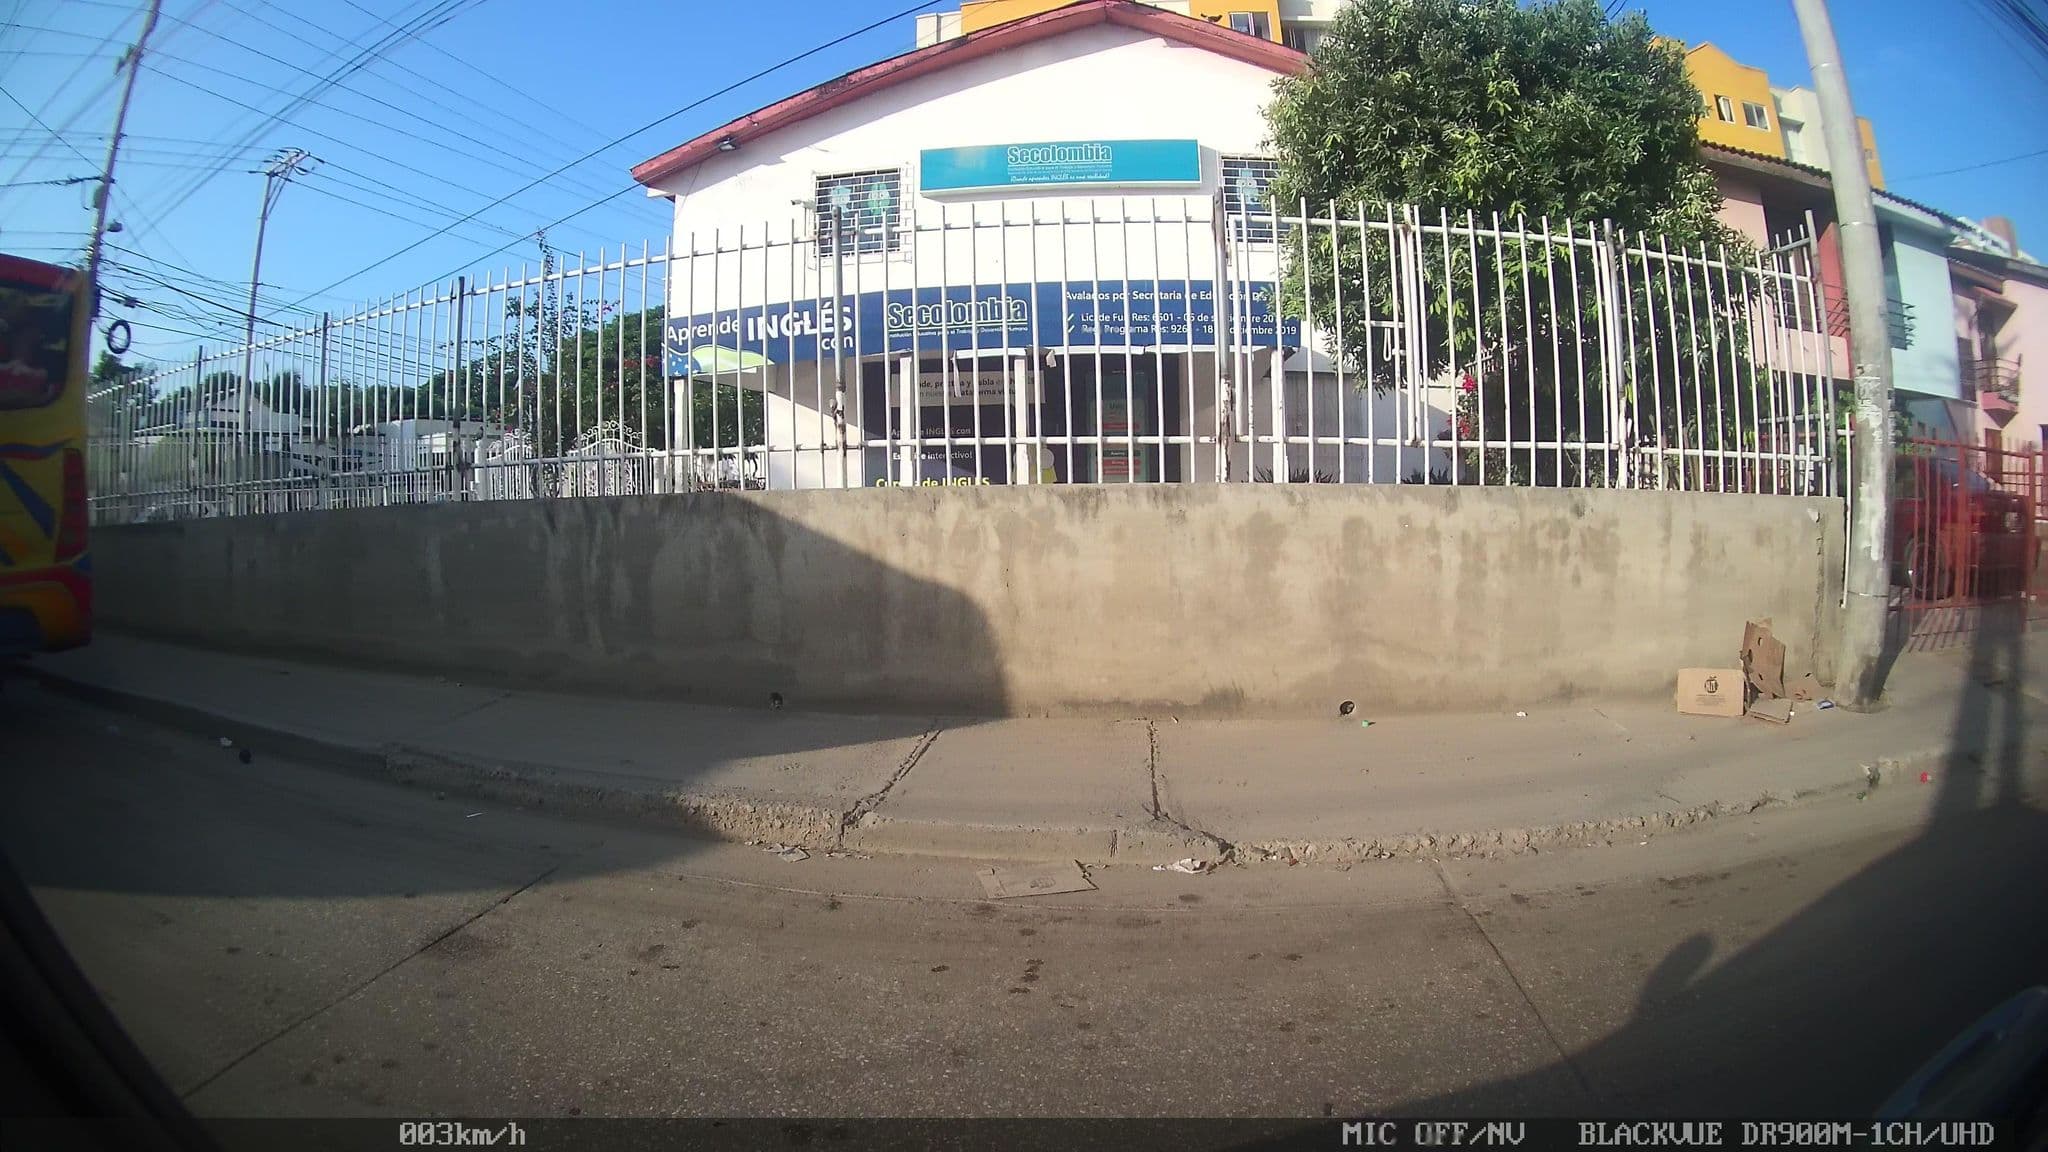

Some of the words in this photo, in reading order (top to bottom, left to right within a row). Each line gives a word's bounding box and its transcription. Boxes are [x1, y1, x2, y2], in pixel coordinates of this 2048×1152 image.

[1007, 144, 1112, 164] Secolombia
[1132, 290, 1182, 300] Secrtaria
[888, 297, 1028, 328] Secolombia
[1132, 312, 1150, 322] Res:
[1197, 312, 1209, 322] de
[668, 315, 738, 346] Aprende
[747, 302, 852, 342] INGLÉS
[1203, 325, 1214, 334] 18
